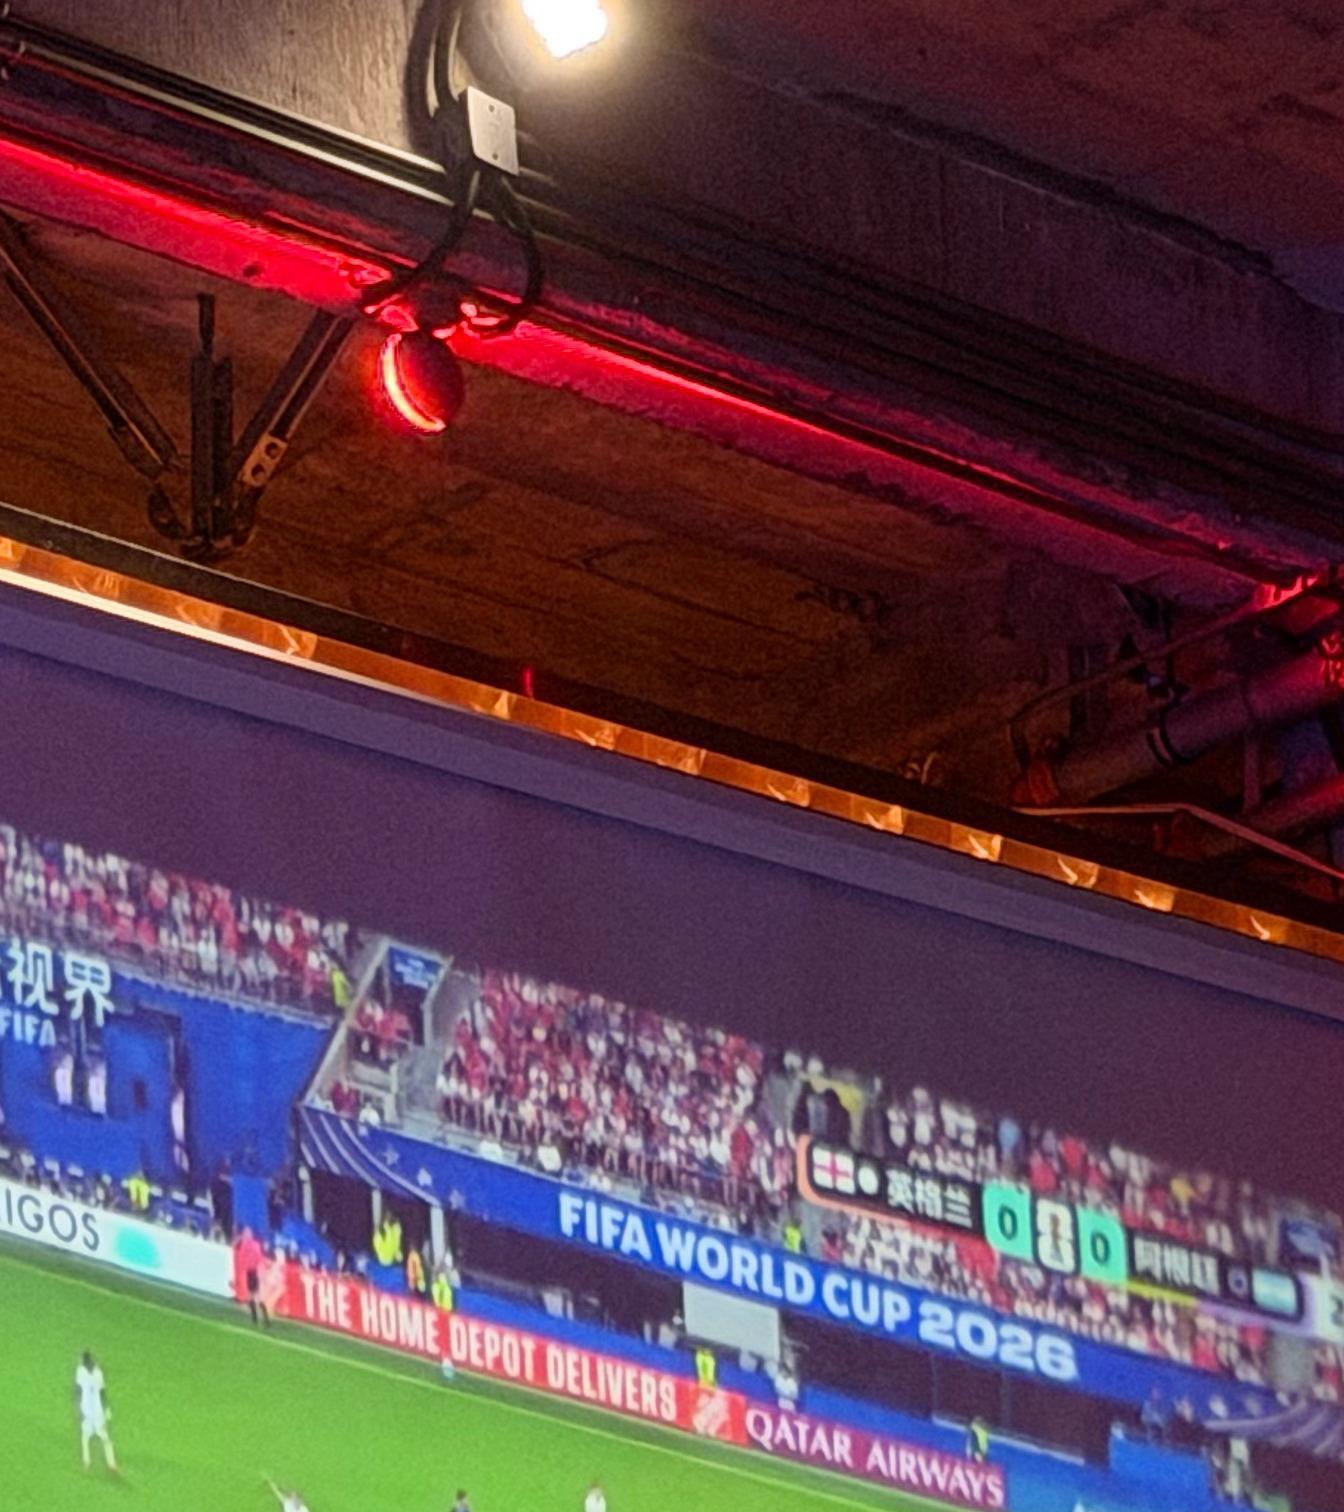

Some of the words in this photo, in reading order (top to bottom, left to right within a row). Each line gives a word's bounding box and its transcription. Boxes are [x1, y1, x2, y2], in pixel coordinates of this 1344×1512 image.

[886, 1168, 973, 1229] 英格兰
[997, 1204, 1020, 1242] 0
[557, 1191, 652, 1262] FIFA
[656, 1211, 816, 1306] WORLD
[822, 1276, 913, 1333] CUP
[918, 1302, 1080, 1382] 2026
[1089, 1232, 1112, 1266] 0
[301, 1274, 353, 1330] THE
[360, 1289, 442, 1354] HOME
[449, 1313, 536, 1382] DEPOT
[544, 1338, 678, 1423] DELIVERS
[745, 1409, 853, 1468] QATAR
[865, 1444, 1007, 1508] AIRWAYS
